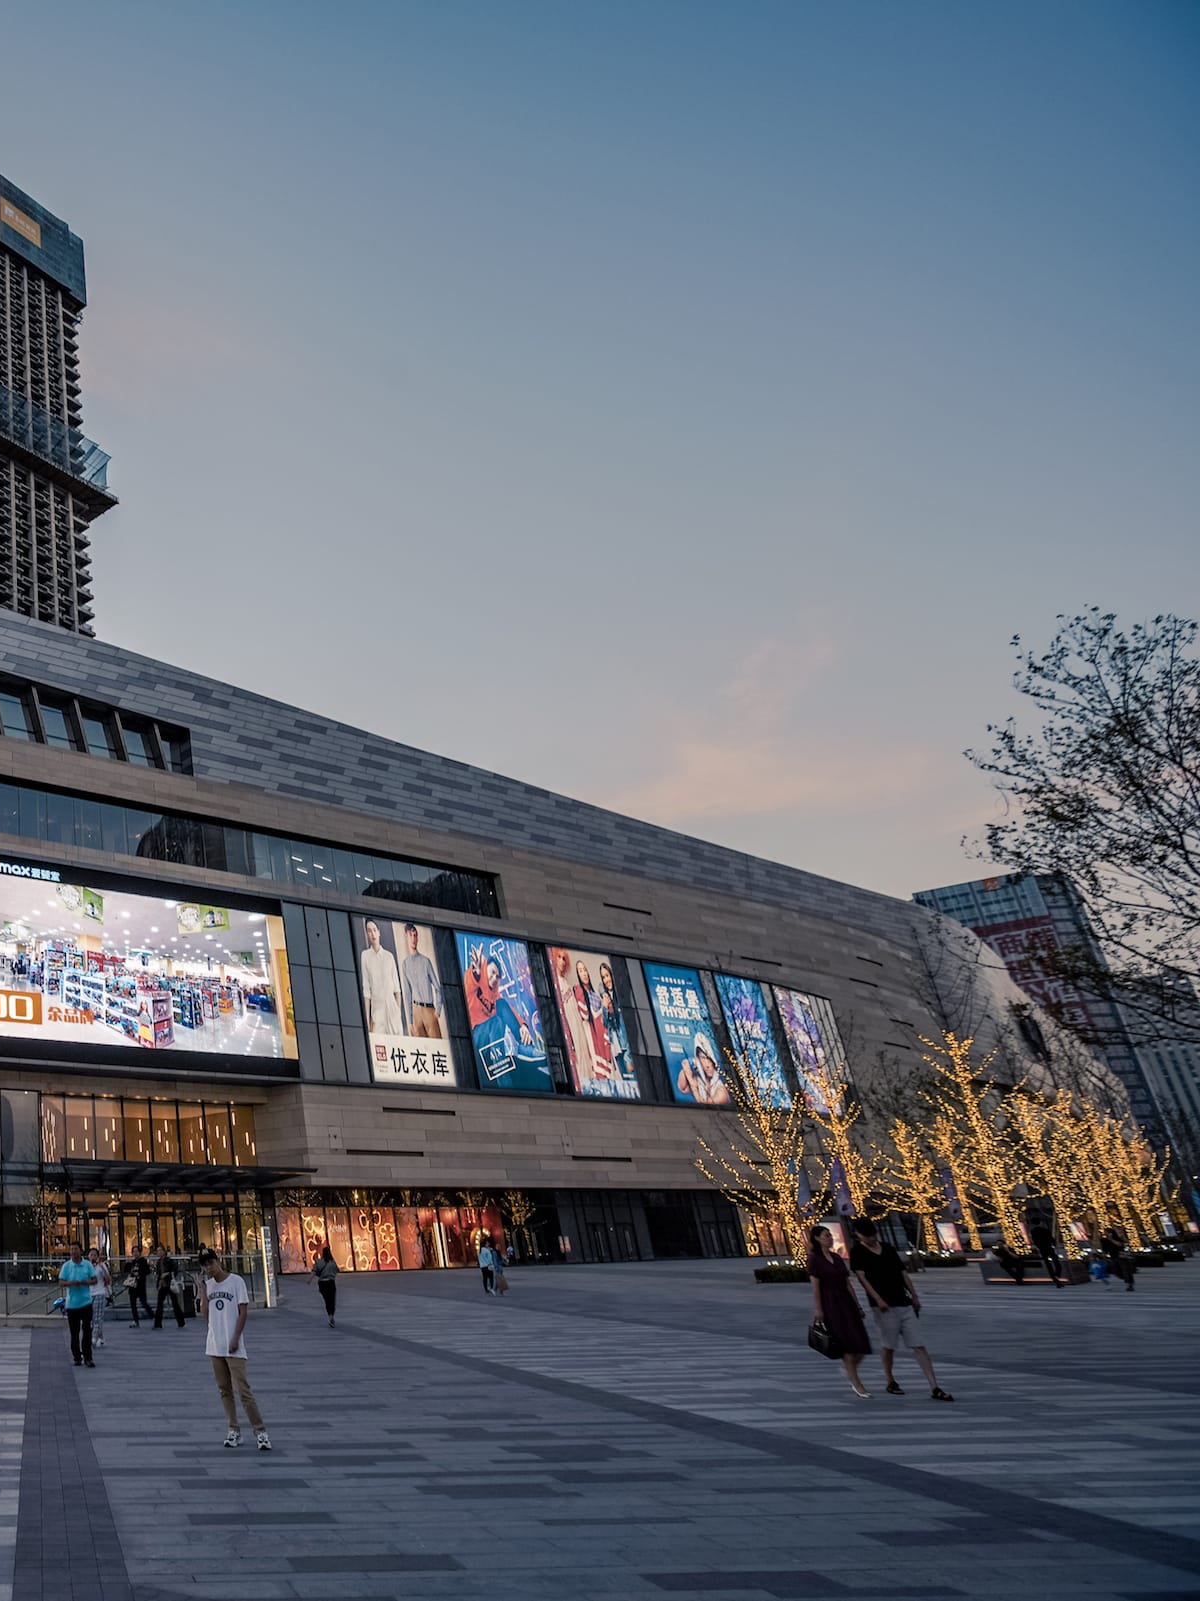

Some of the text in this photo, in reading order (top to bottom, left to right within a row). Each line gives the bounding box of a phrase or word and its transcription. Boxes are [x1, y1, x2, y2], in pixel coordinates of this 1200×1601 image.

[655, 984, 699, 1009] 舒适堡
[47, 1006, 94, 1025] 余品牌
[390, 1047, 449, 1077] 优衣库
